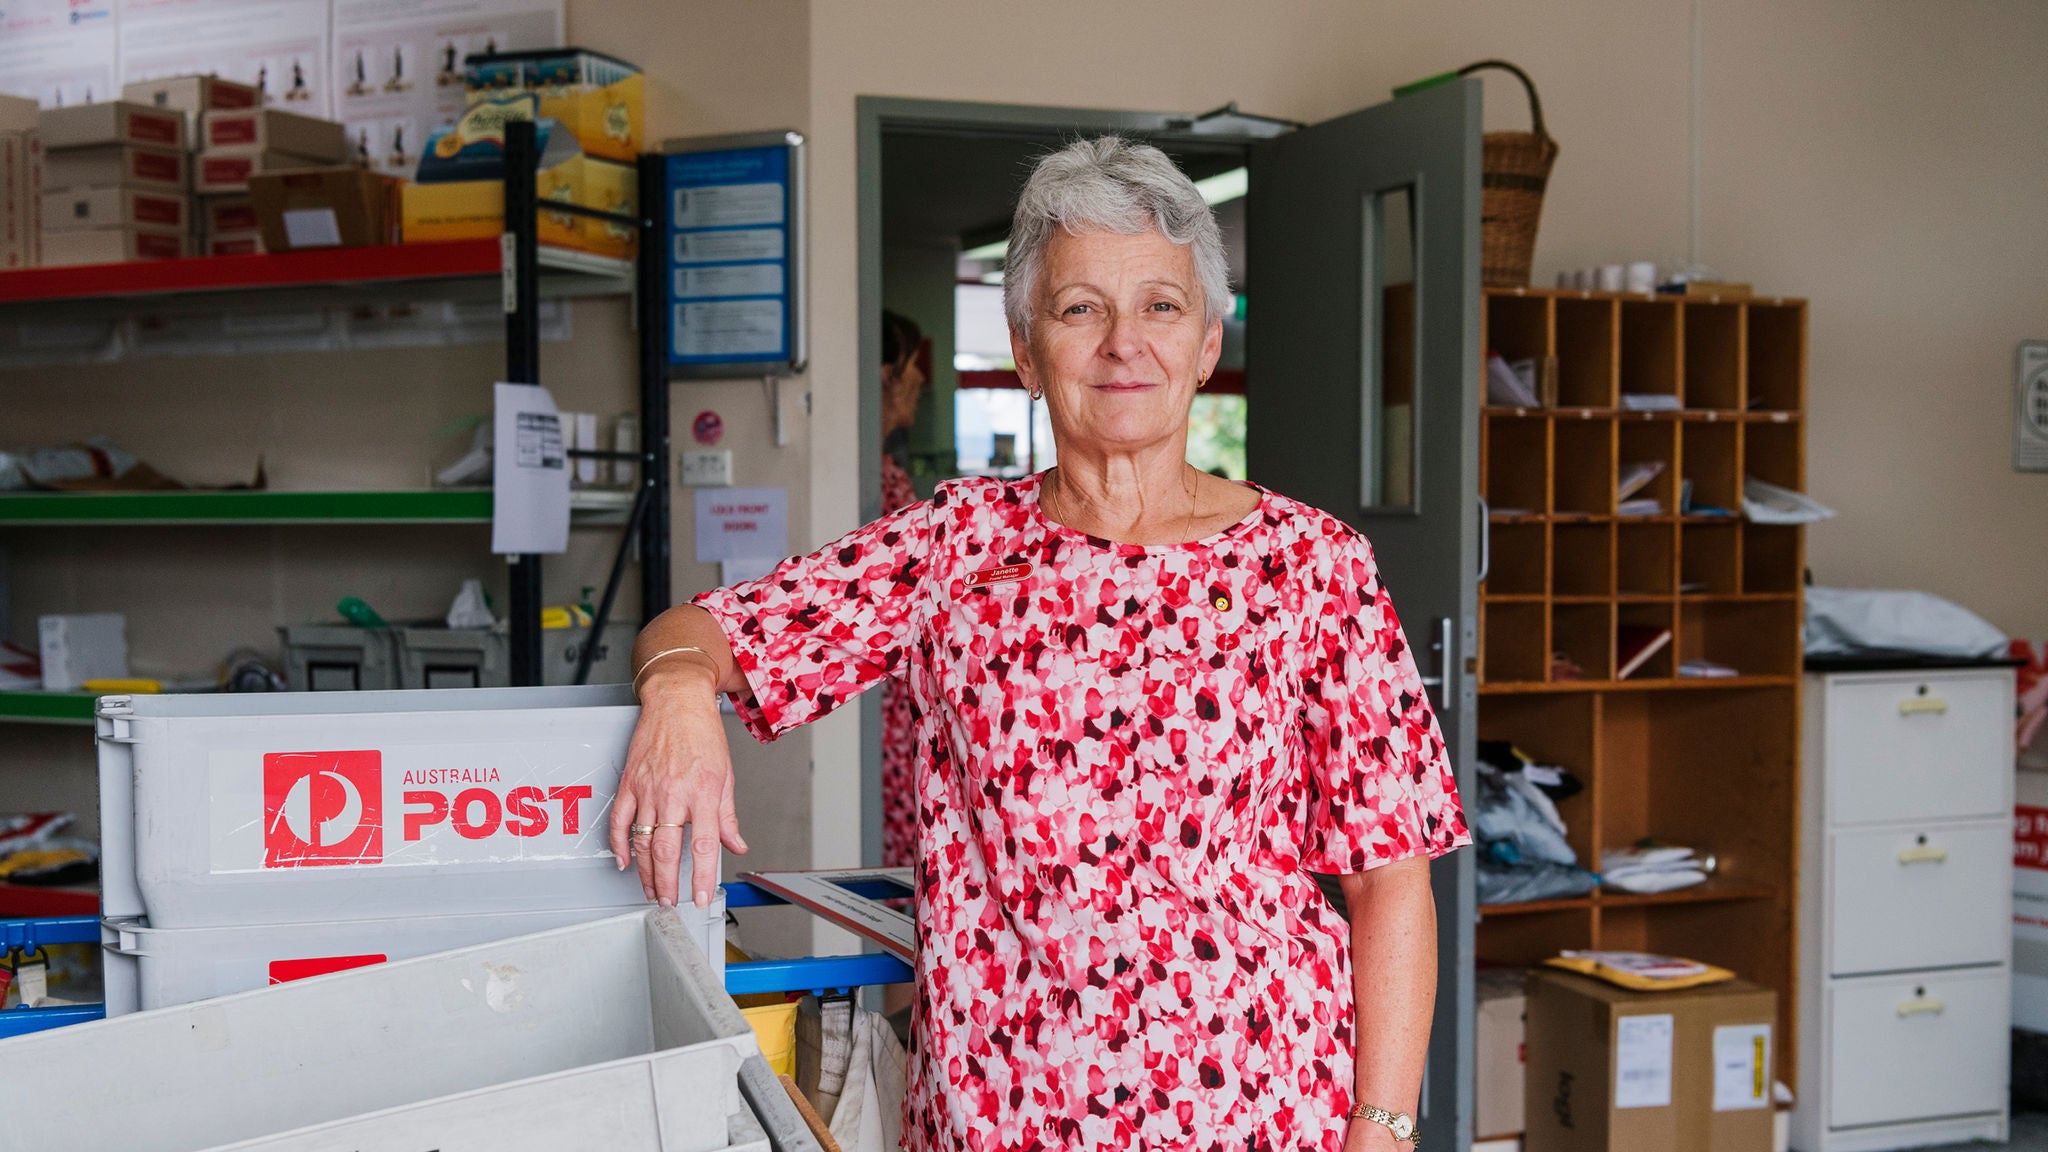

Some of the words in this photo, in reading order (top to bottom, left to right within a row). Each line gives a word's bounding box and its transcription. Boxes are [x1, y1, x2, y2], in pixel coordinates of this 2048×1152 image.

[991, 567, 1019, 576] Janette
[403, 767, 500, 785] AUSTRALIA
[403, 785, 593, 842] POST
